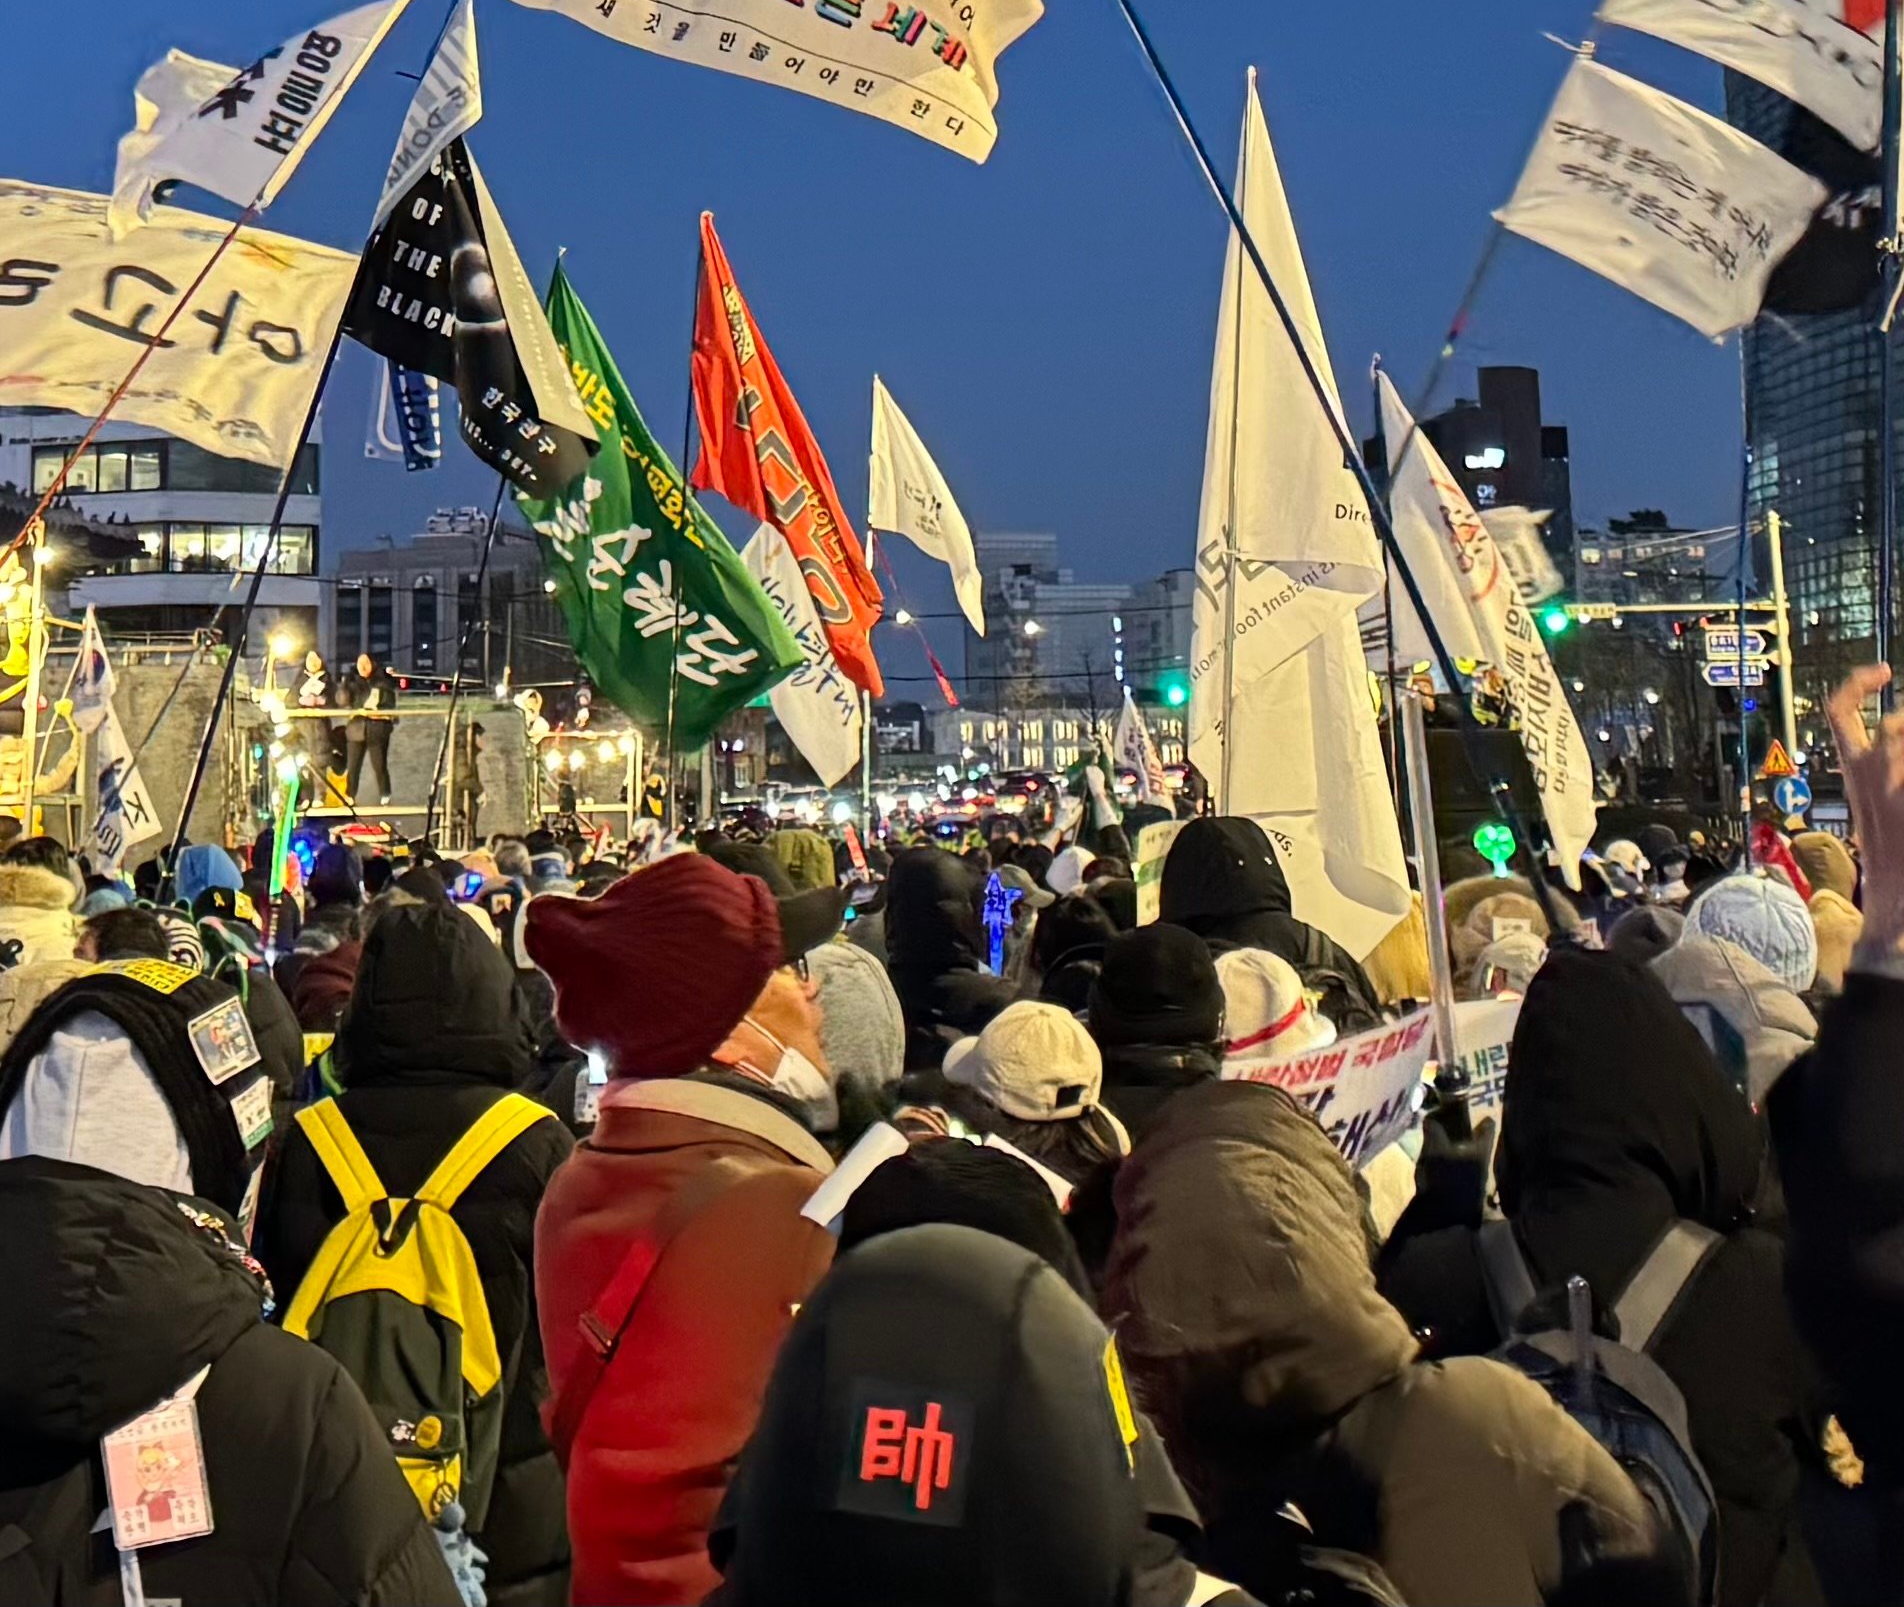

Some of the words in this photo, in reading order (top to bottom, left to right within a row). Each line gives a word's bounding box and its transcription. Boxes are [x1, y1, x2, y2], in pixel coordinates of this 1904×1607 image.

[412, 198, 442, 226] OF
[394, 239, 441, 278] THE
[377, 285, 456, 337] BLACK
